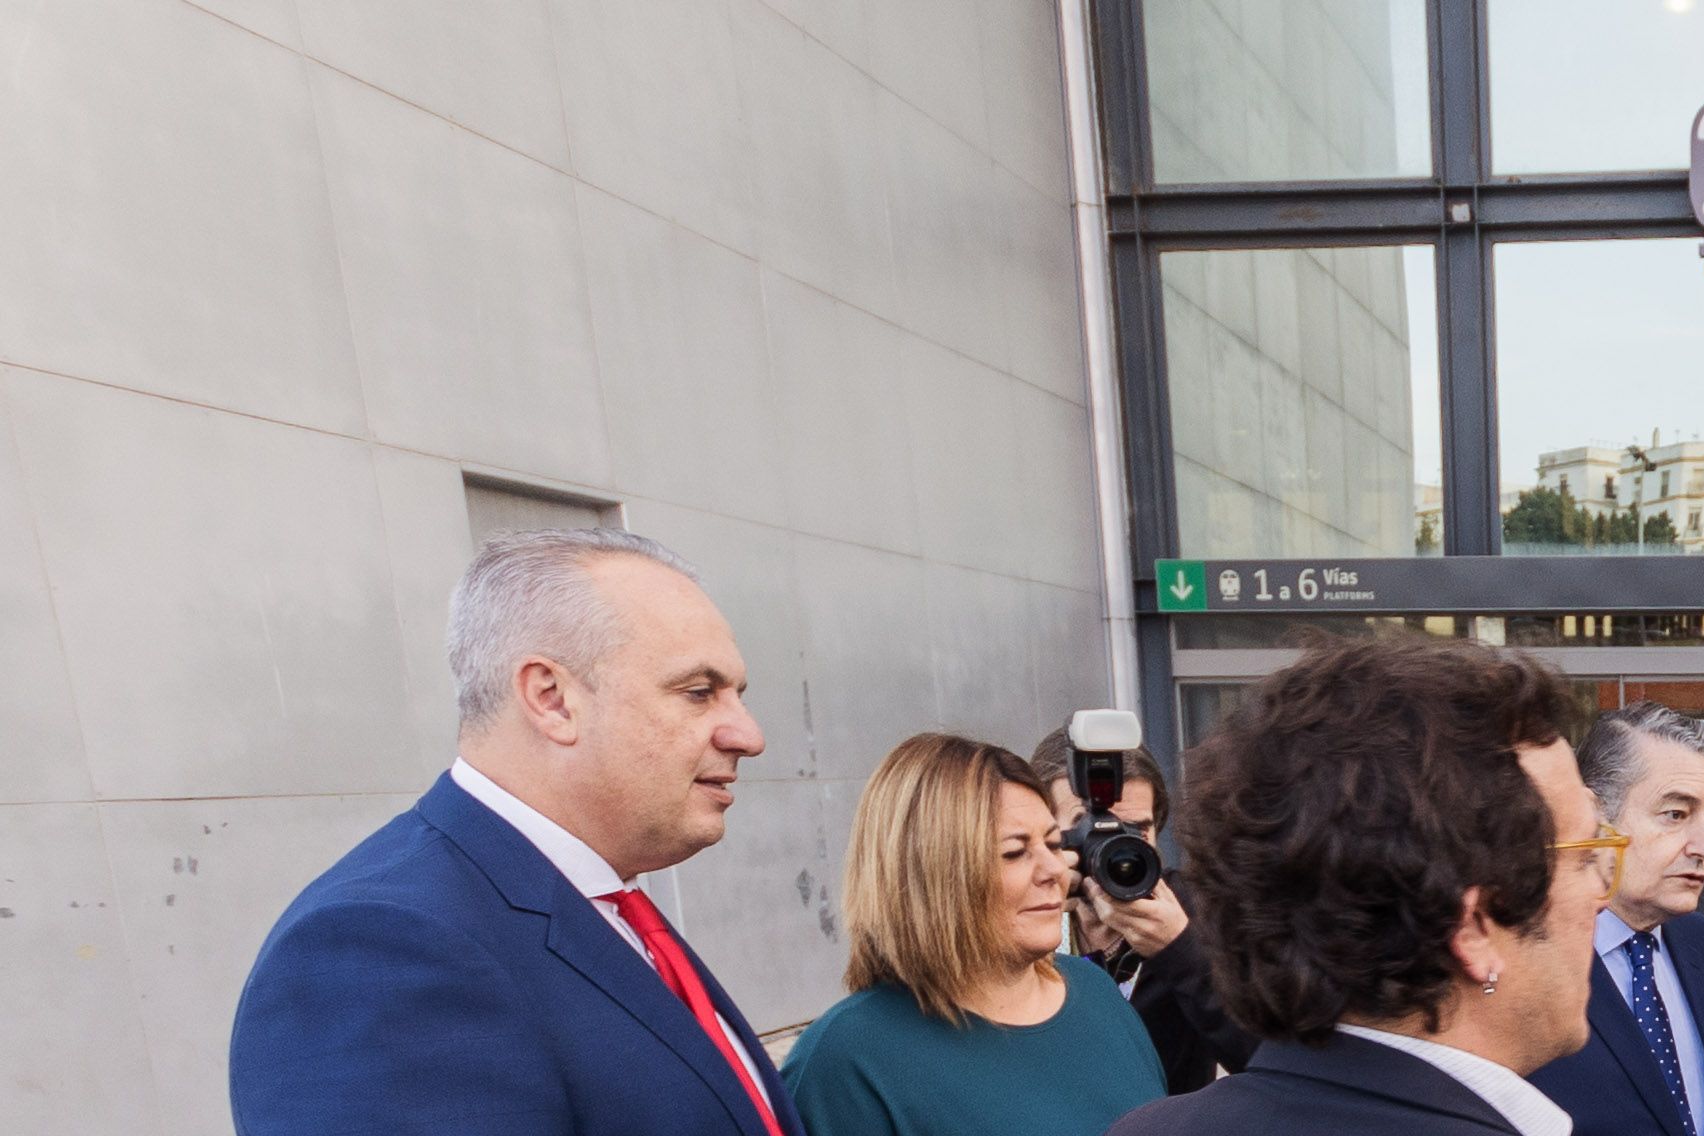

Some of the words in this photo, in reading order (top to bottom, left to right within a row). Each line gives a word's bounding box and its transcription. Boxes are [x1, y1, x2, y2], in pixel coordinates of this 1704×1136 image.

[1253, 569, 1273, 600] 1
[1279, 585, 1291, 600] a
[1298, 568, 1318, 600] 6
[1322, 567, 1359, 586] Vías
[1323, 591, 1375, 600] PLATFORMS
